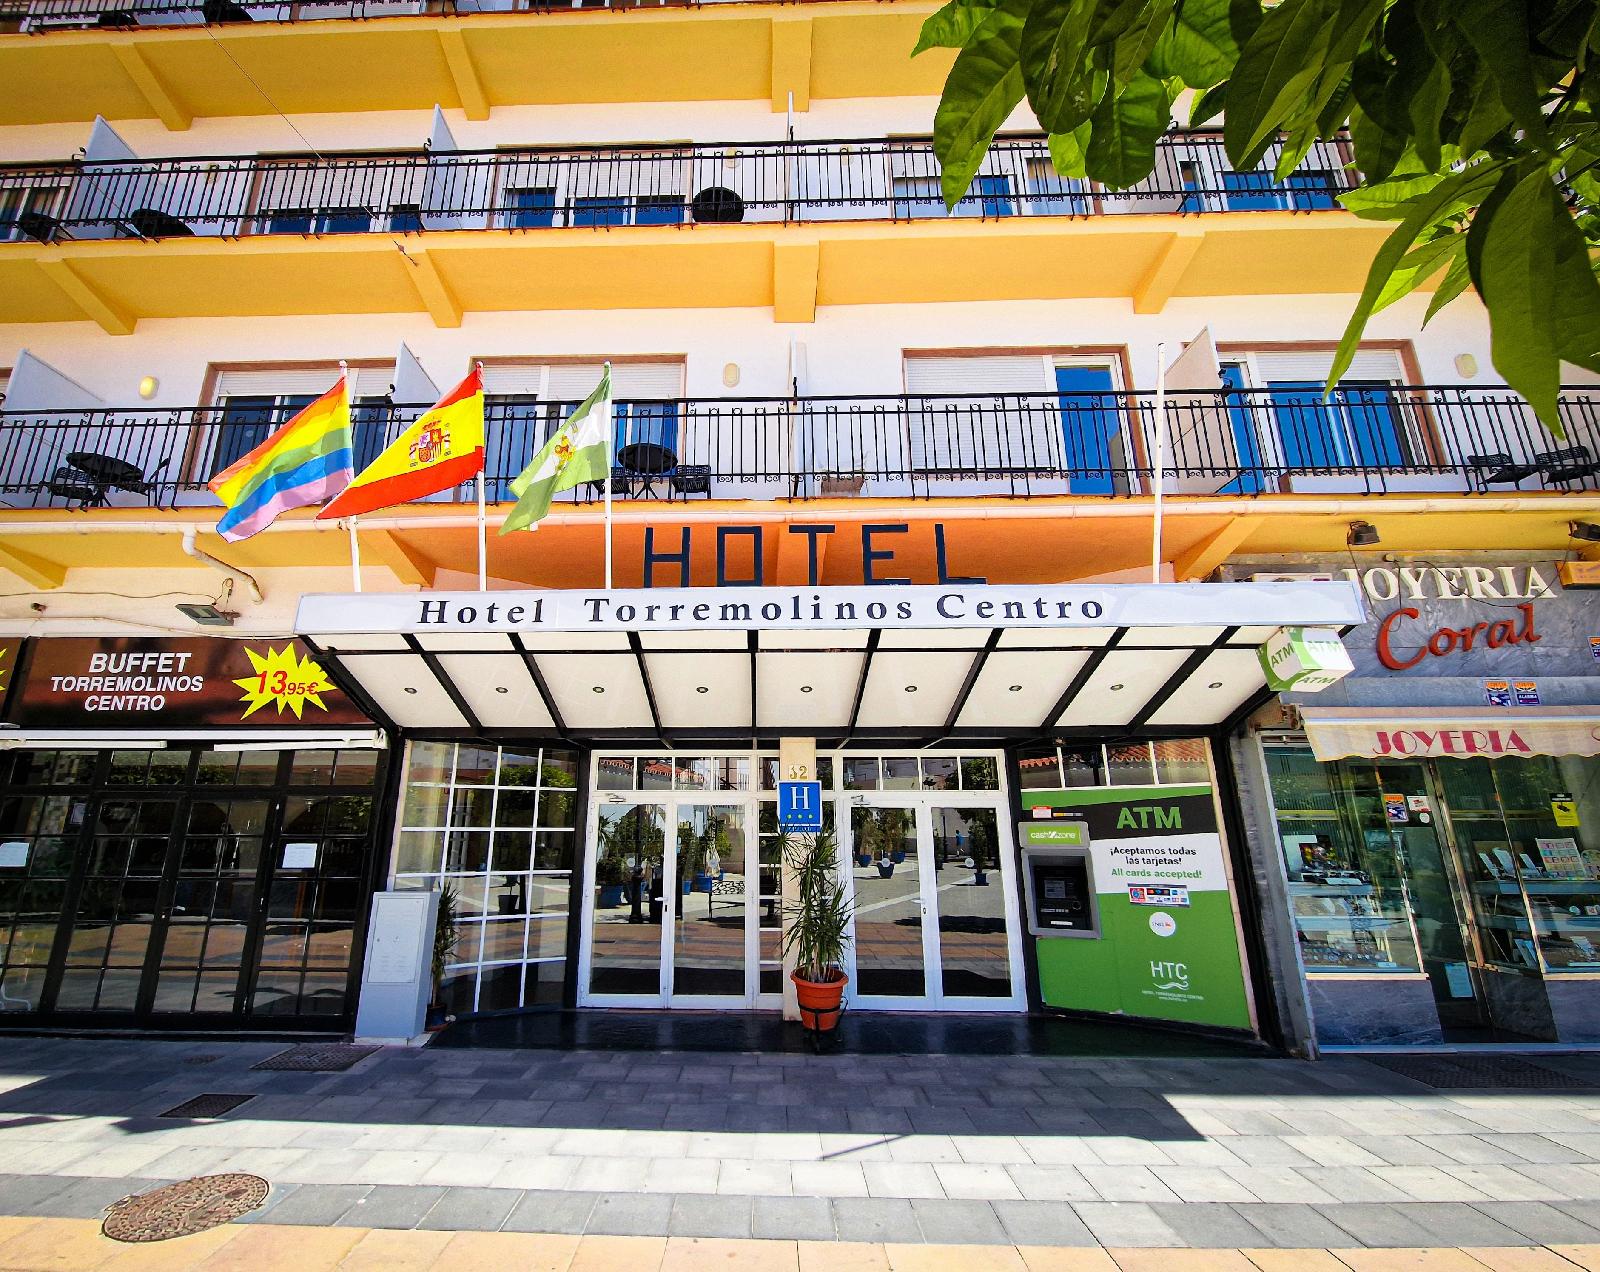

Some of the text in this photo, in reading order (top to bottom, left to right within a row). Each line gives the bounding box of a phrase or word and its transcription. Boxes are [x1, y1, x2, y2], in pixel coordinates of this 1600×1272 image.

[643, 523, 987, 588] HOTEL
[416, 593, 1104, 624] Hotel Torremolinos Centro
[1375, 603, 1542, 670] Coral
[88, 652, 191, 673] BUFFET
[1270, 642, 1295, 668] ATM
[51, 676, 204, 692] TORREMOLINOS
[255, 670, 319, 697] 13,95€
[84, 694, 165, 711] CENTRO
[1372, 729, 1531, 754] JOYERIA
[790, 786, 811, 810] H
[1116, 806, 1182, 829] ATM
[1110, 846, 1197, 856] ¡Aceptamos todas
[1125, 856, 1182, 866] las tarjetas!
[1111, 868, 1203, 879] All cards accepted!
[1150, 961, 1188, 980] HTC
